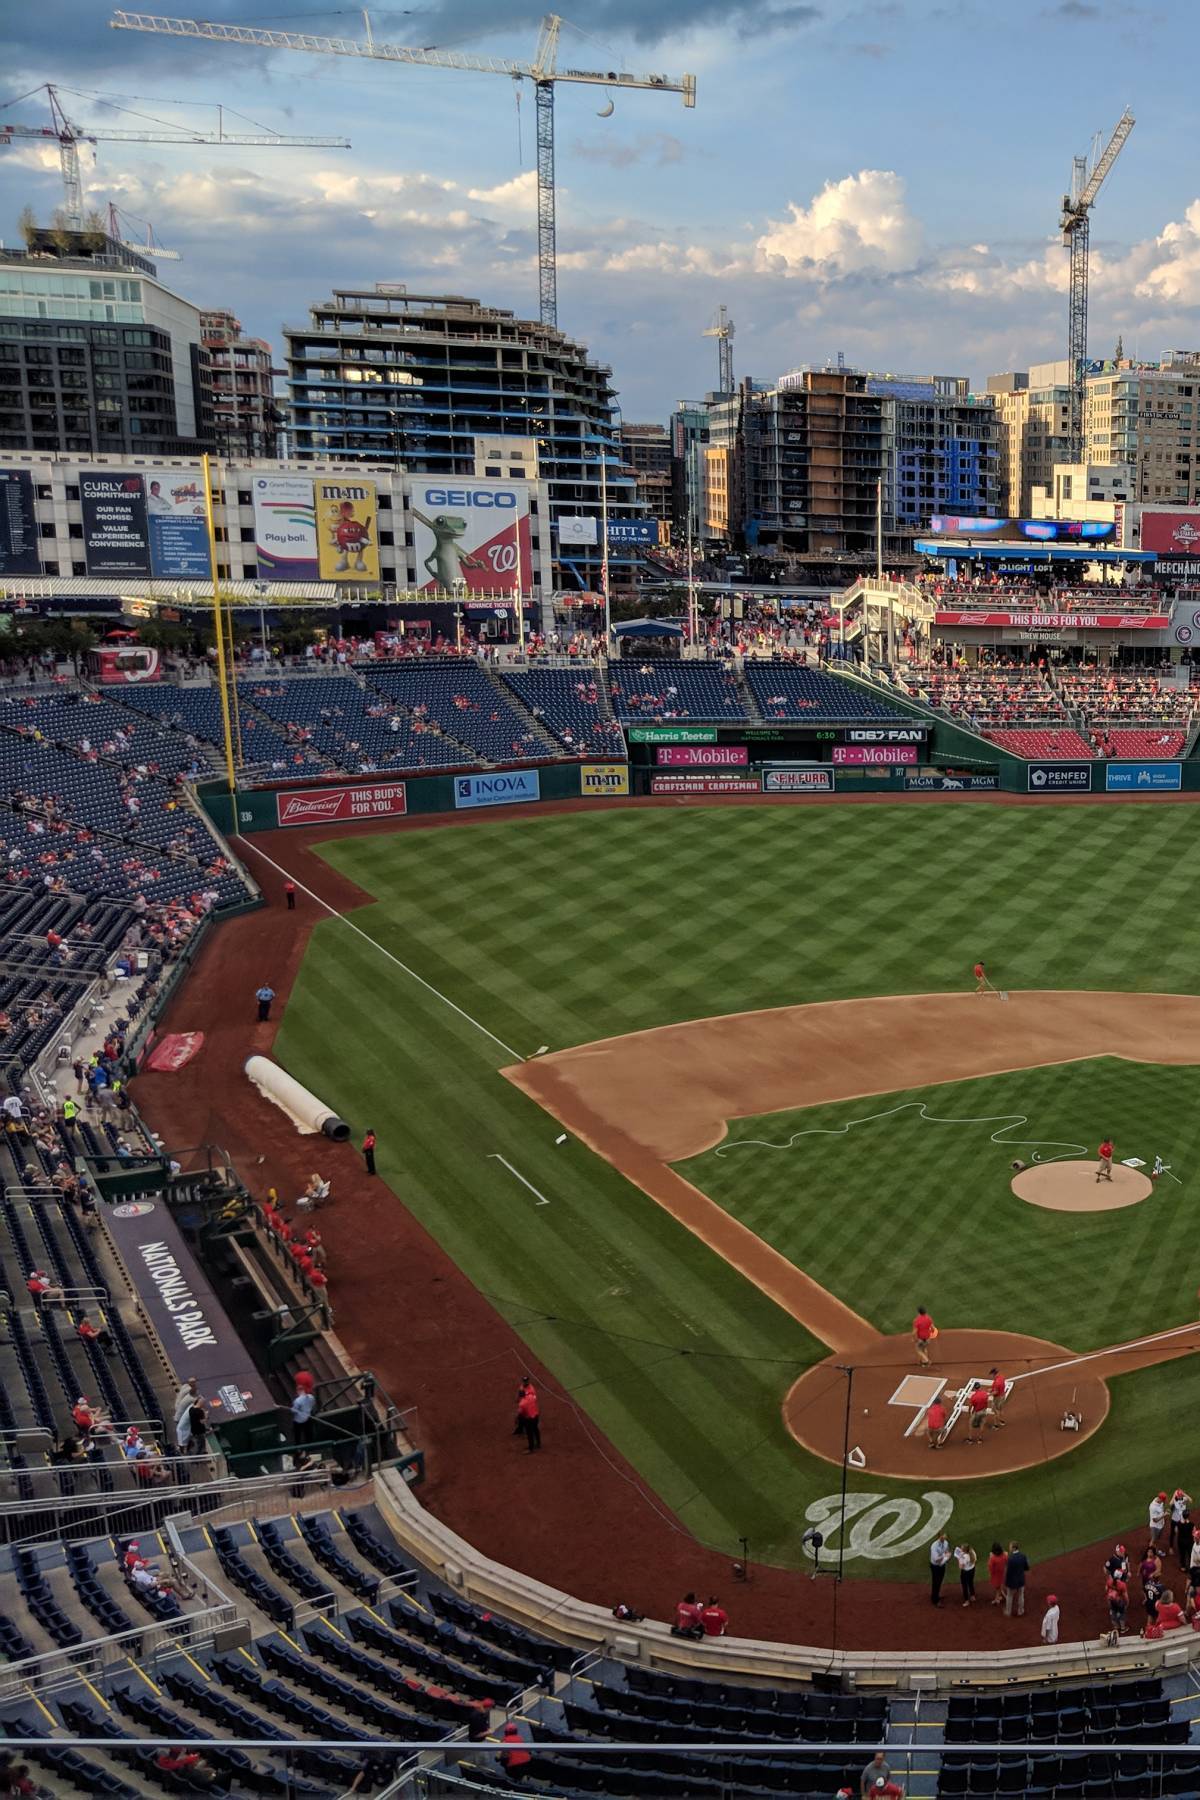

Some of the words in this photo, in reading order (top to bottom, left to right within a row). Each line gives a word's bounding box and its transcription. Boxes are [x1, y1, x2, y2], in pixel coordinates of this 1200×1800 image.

[83, 482, 123, 492] CURLY
[425, 489, 516, 508] GEICO
[265, 533, 286, 543] Play
[1008, 564, 1032, 572] LIGHT
[1008, 615, 1030, 625] THIS
[1031, 615, 1058, 625] BUD'S
[1060, 615, 1079, 626] FOR
[1080, 615, 1100, 626] YOU.
[1020, 632, 1038, 640] BREW
[1039, 632, 1060, 640] HOUSE
[645, 731, 678, 741] Harris
[680, 731, 714, 740] Teeter
[816, 731, 836, 740] 6:30
[888, 731, 922, 740] FAN
[801, 774, 826, 783] FURR
[1048, 772, 1087, 780] PENFED
[476, 777, 526, 794] INOVA
[654, 782, 704, 790] CRAFTSMAN
[708, 782, 758, 790] CRAFTSMAN
[909, 778, 934, 786] MGM
[351, 791, 372, 802] THIS
[374, 787, 403, 800] BUD'S
[287, 799, 342, 814] Budweiser
[351, 803, 370, 814] FOR
[371, 800, 394, 812] YOU.
[240, 812, 253, 823] 336
[138, 1241, 198, 1312] NATIONALS
[172, 1310, 218, 1351] PARK
